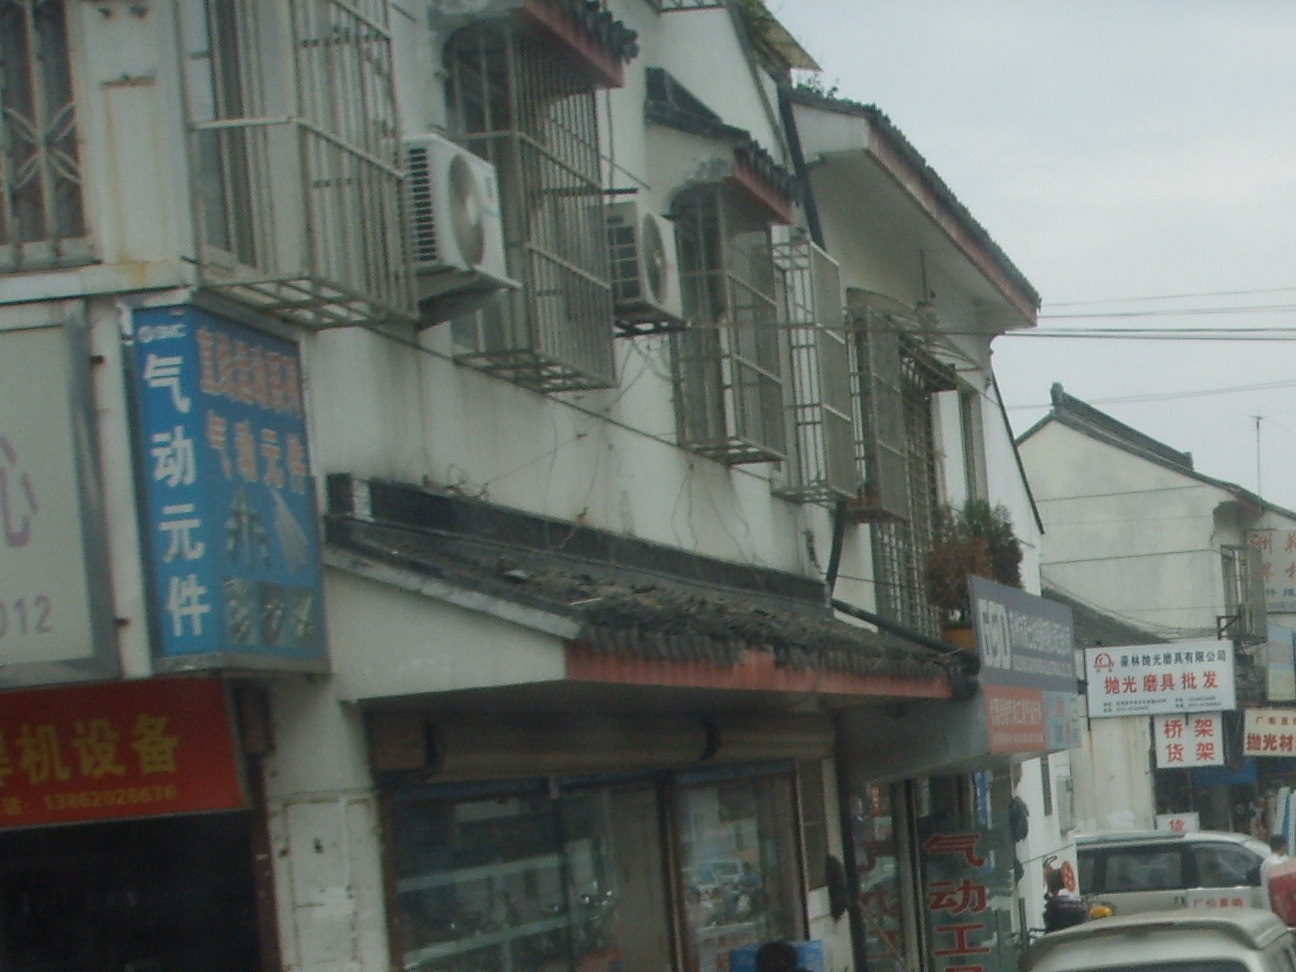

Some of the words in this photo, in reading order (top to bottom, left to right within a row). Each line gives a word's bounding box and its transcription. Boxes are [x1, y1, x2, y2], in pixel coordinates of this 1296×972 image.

[143, 353, 212, 638] 气动元件
[1104, 671, 1219, 695] 抛光磨具批发
[1164, 718, 1214, 739] 桥架
[1166, 741, 1215, 763] 货架
